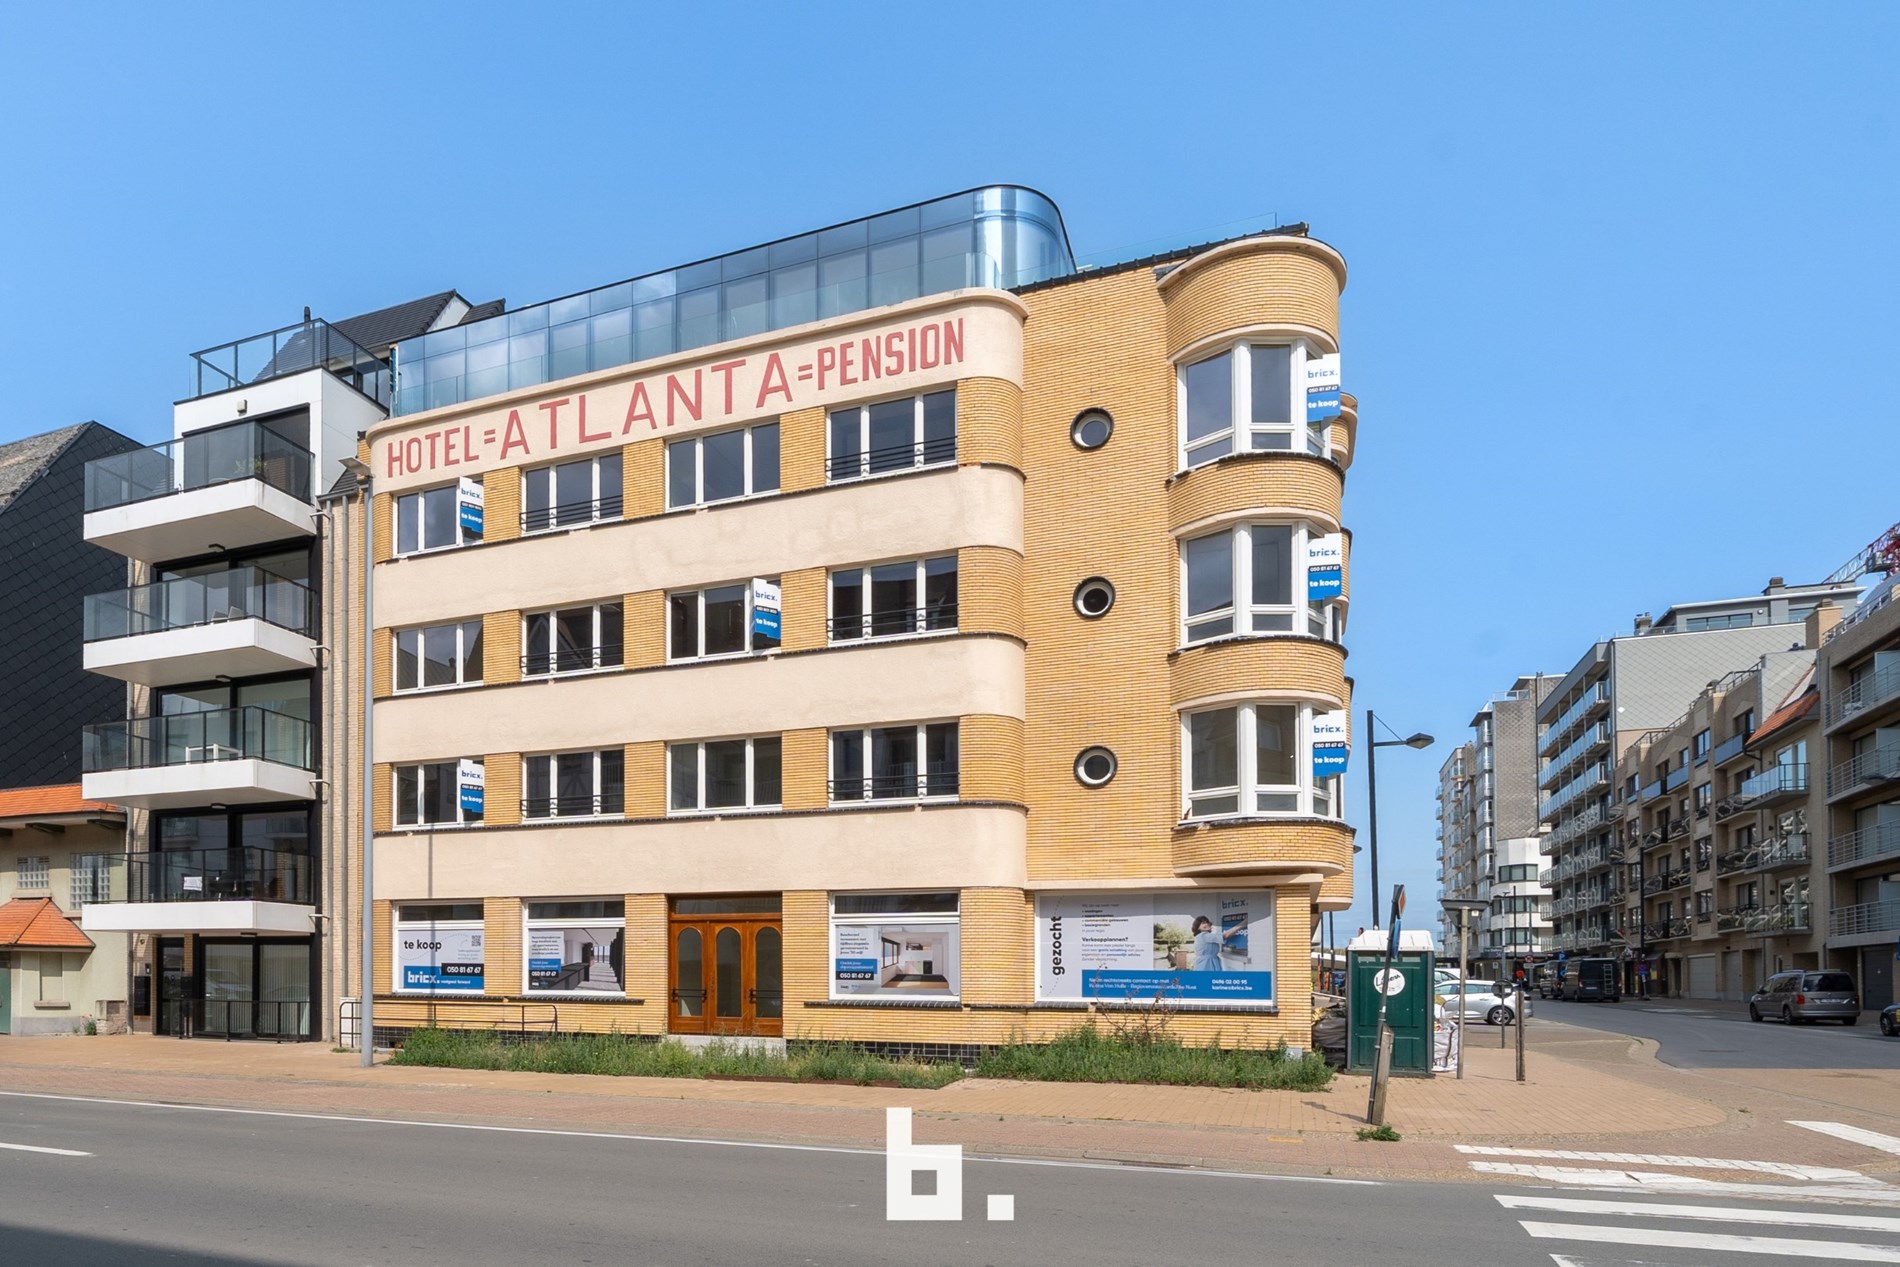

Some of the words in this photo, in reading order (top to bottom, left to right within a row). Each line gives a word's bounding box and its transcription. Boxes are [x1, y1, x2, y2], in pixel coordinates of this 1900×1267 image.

[1318, 400, 1338, 408] koop
[468, 514, 482, 524] koop
[1319, 579, 1340, 587] koop
[763, 618, 778, 628] koop
[1324, 756, 1344, 764] koop
[468, 796, 482, 804] koop
[404, 940, 414, 949] te
[417, 939, 442, 952] koop
[1050, 916, 1065, 975] gezocht
[408, 971, 440, 984] bricx.
